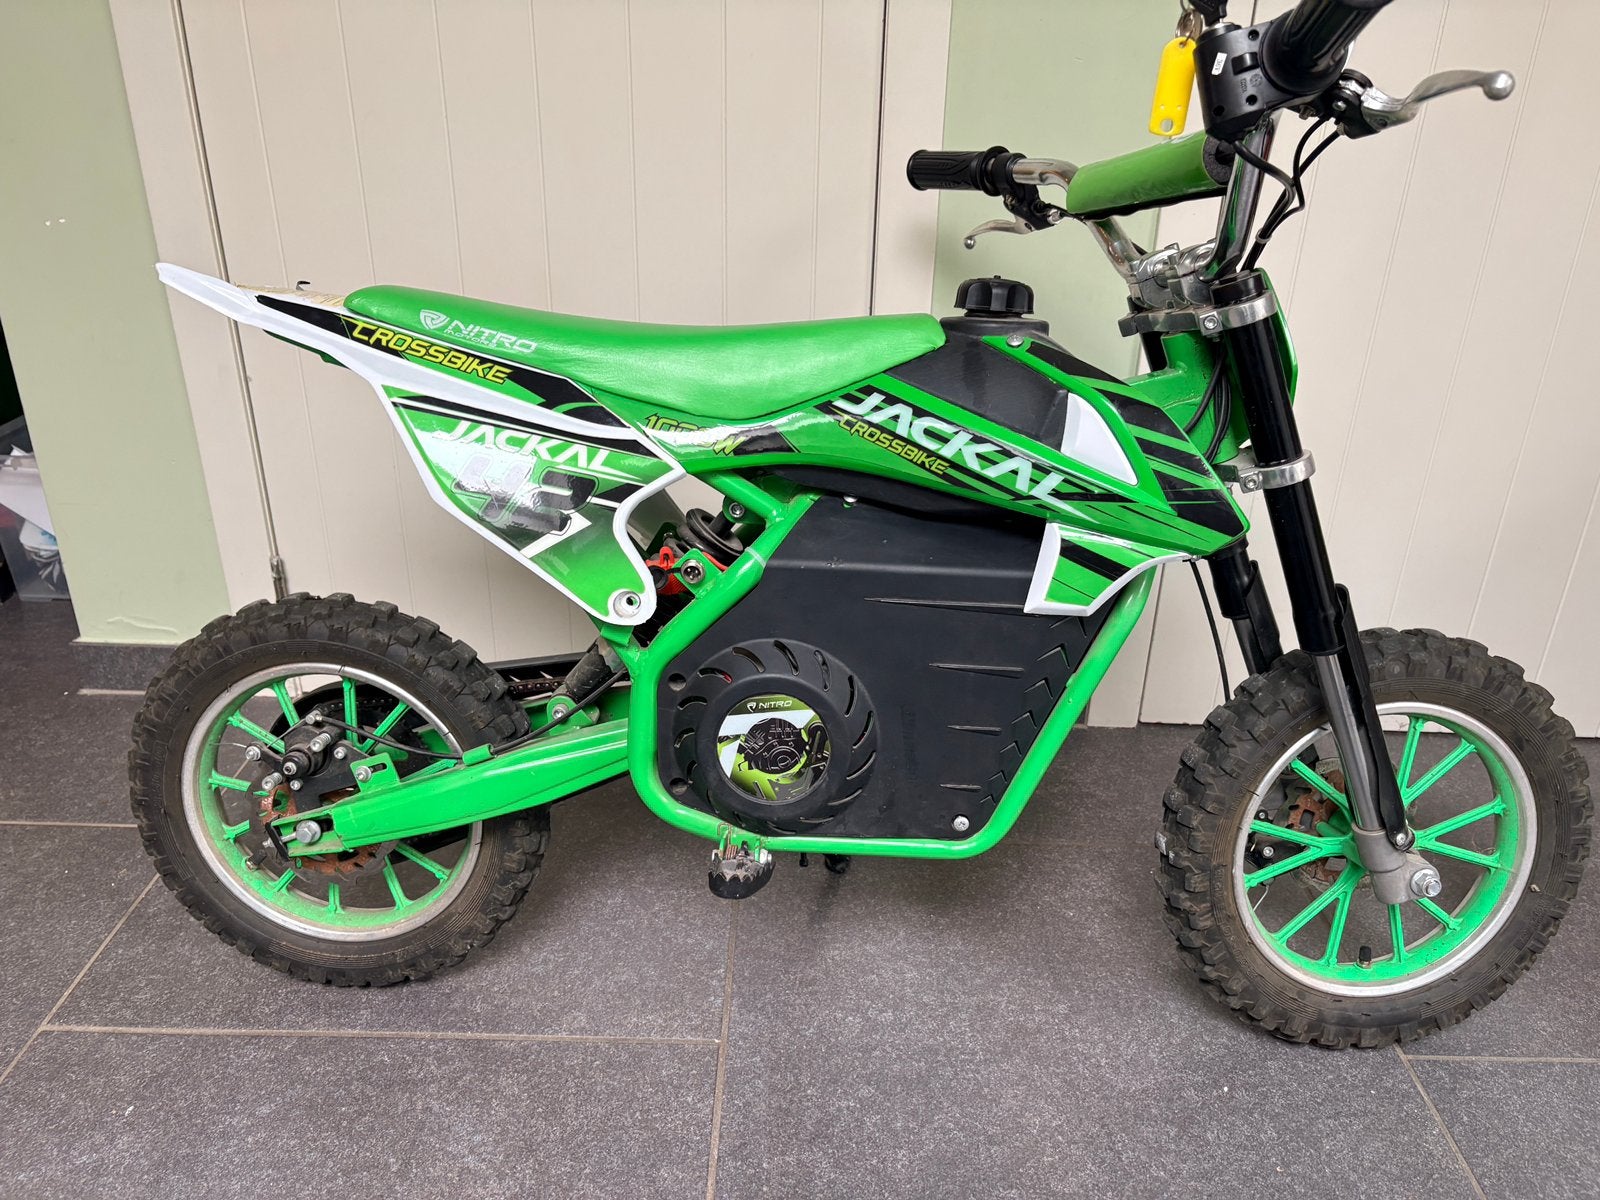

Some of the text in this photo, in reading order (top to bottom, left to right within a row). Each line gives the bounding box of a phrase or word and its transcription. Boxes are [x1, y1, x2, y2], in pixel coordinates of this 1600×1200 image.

[349, 319, 513, 384] CROSSBIKE
[447, 320, 538, 353] NITRO
[437, 420, 641, 481] JACKAL
[832, 409, 952, 475] CROSSBIKE
[833, 391, 1099, 524] JACKAL
[758, 700, 793, 709] NITRO
